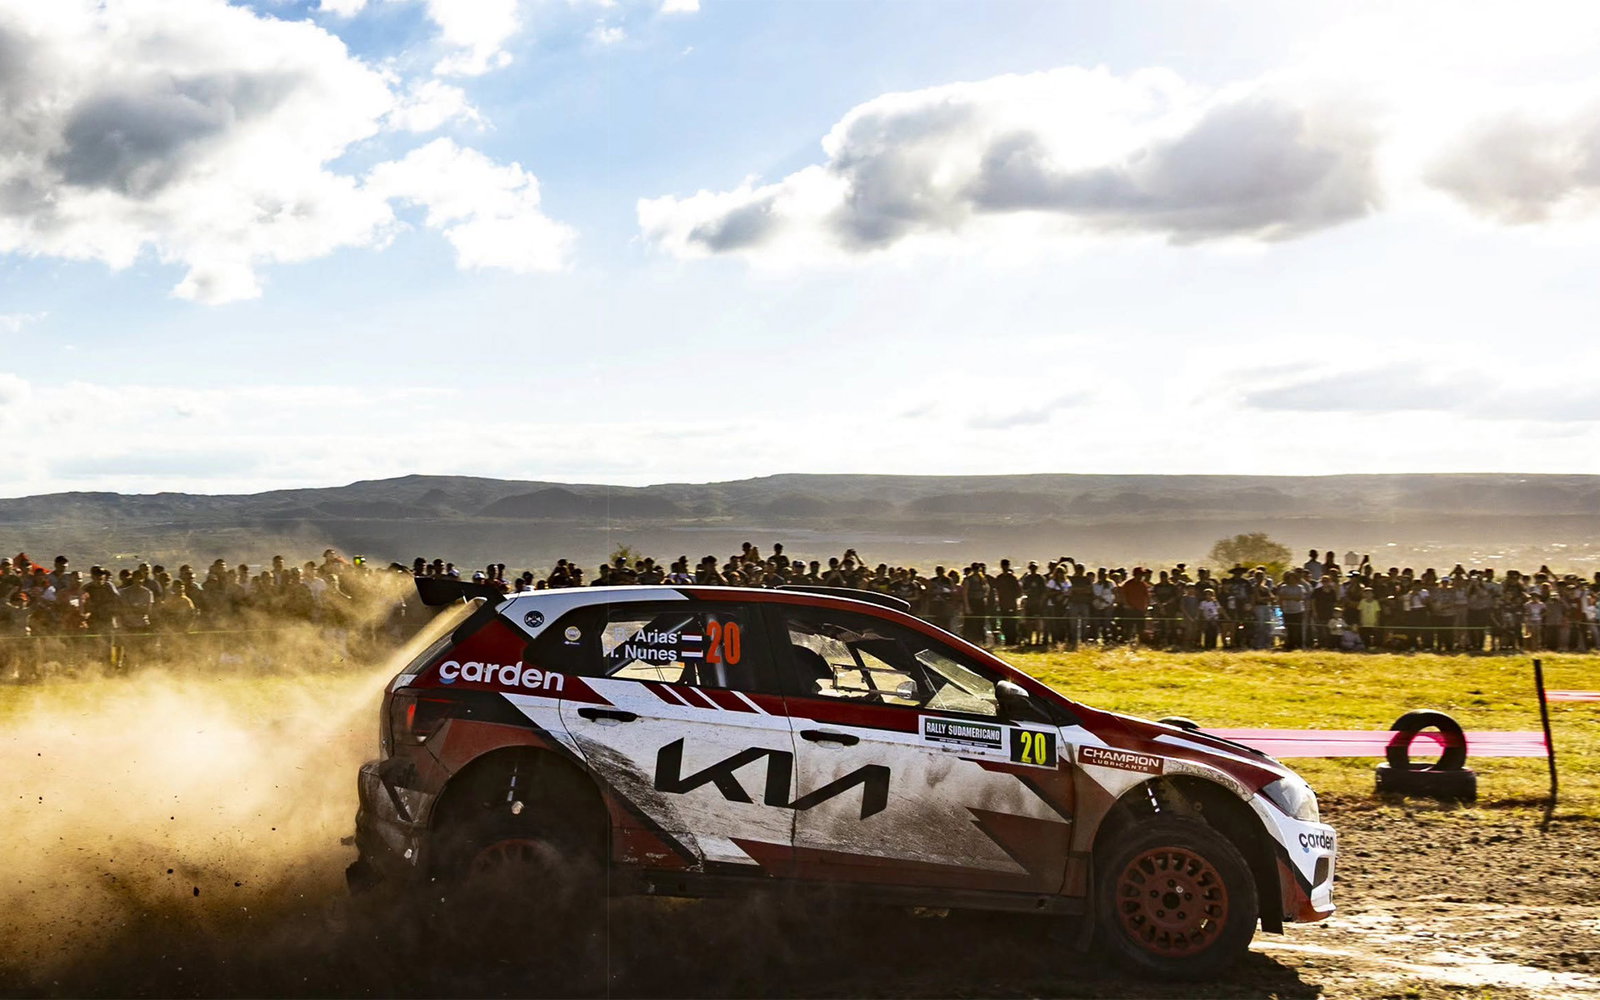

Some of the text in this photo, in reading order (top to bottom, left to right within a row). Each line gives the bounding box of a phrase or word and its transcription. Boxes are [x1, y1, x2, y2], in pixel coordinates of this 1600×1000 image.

[635, 628, 678, 644] Arias
[706, 620, 740, 665] 20
[624, 644, 677, 660] Nunes
[439, 660, 565, 691] carden
[926, 722, 1000, 741] RALLY SUDAMERICANO
[1020, 731, 1047, 765] 20
[1083, 748, 1160, 767] CHAMPION
[1092, 758, 1149, 771] LUBRICANTS
[654, 737, 891, 821] KIA
[1298, 831, 1334, 851] carden
